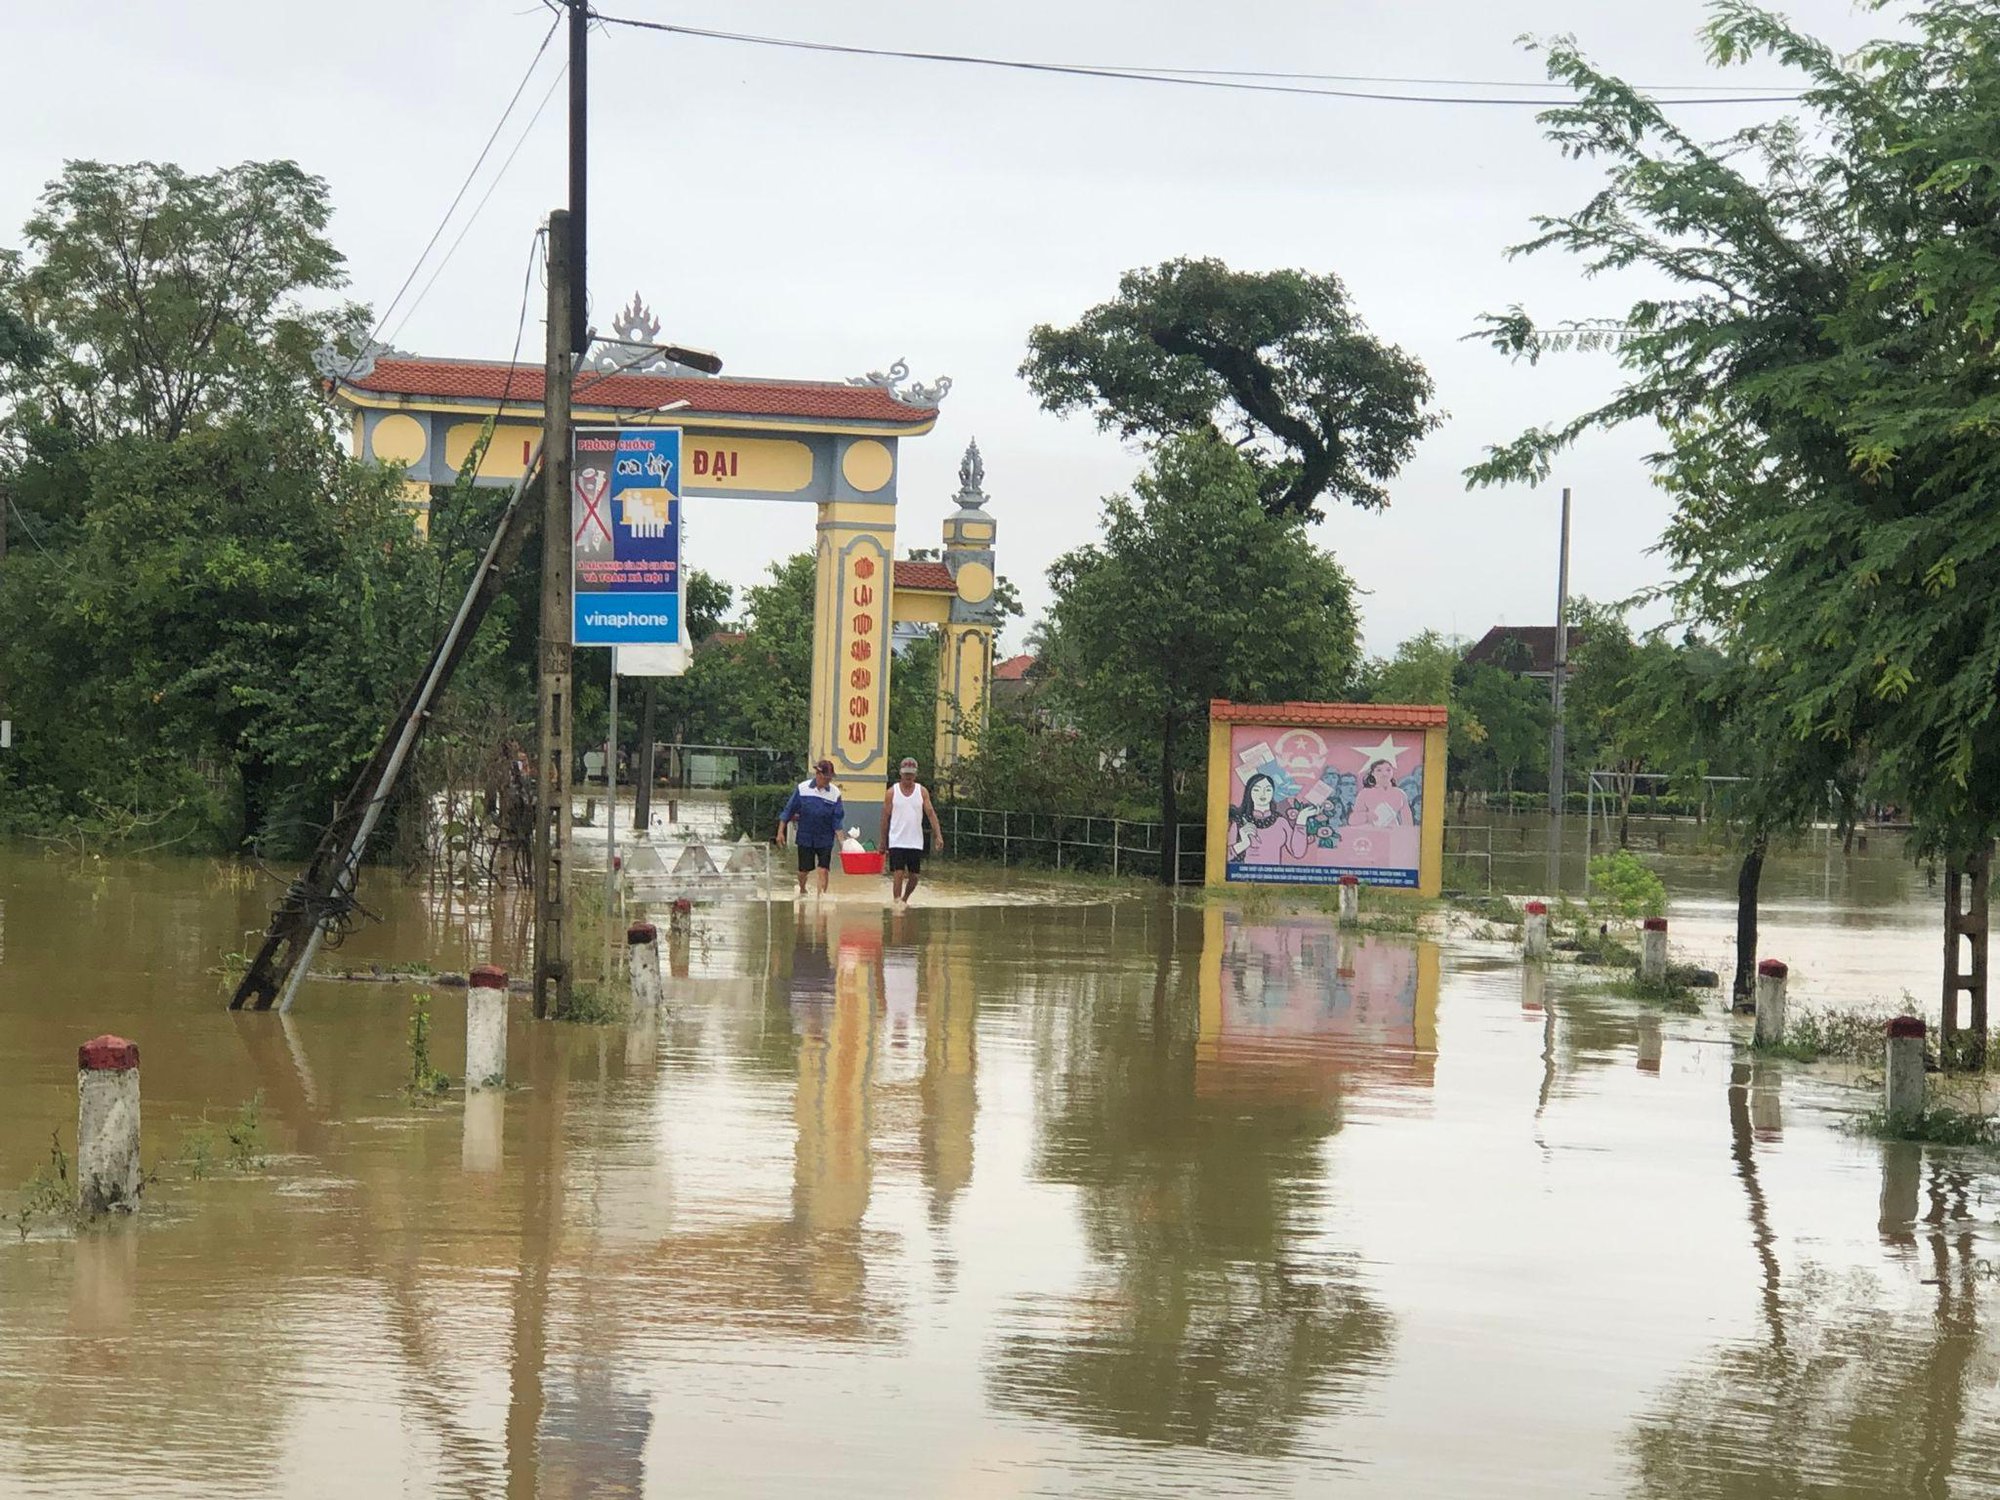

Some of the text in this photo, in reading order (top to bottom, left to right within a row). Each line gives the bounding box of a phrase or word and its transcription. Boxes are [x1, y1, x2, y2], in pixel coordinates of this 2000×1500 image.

[577, 437, 656, 452] PHÒNG CHỐNG
[617, 459, 642, 476] ma
[693, 450, 738, 481] ĐẠI
[583, 571, 597, 583] VÀ
[599, 571, 627, 583] TOÀN
[644, 571, 663, 584] HỘI
[853, 584, 873, 607] LAI
[584, 611, 668, 628] vinaphone
[849, 695, 869, 718] CON
